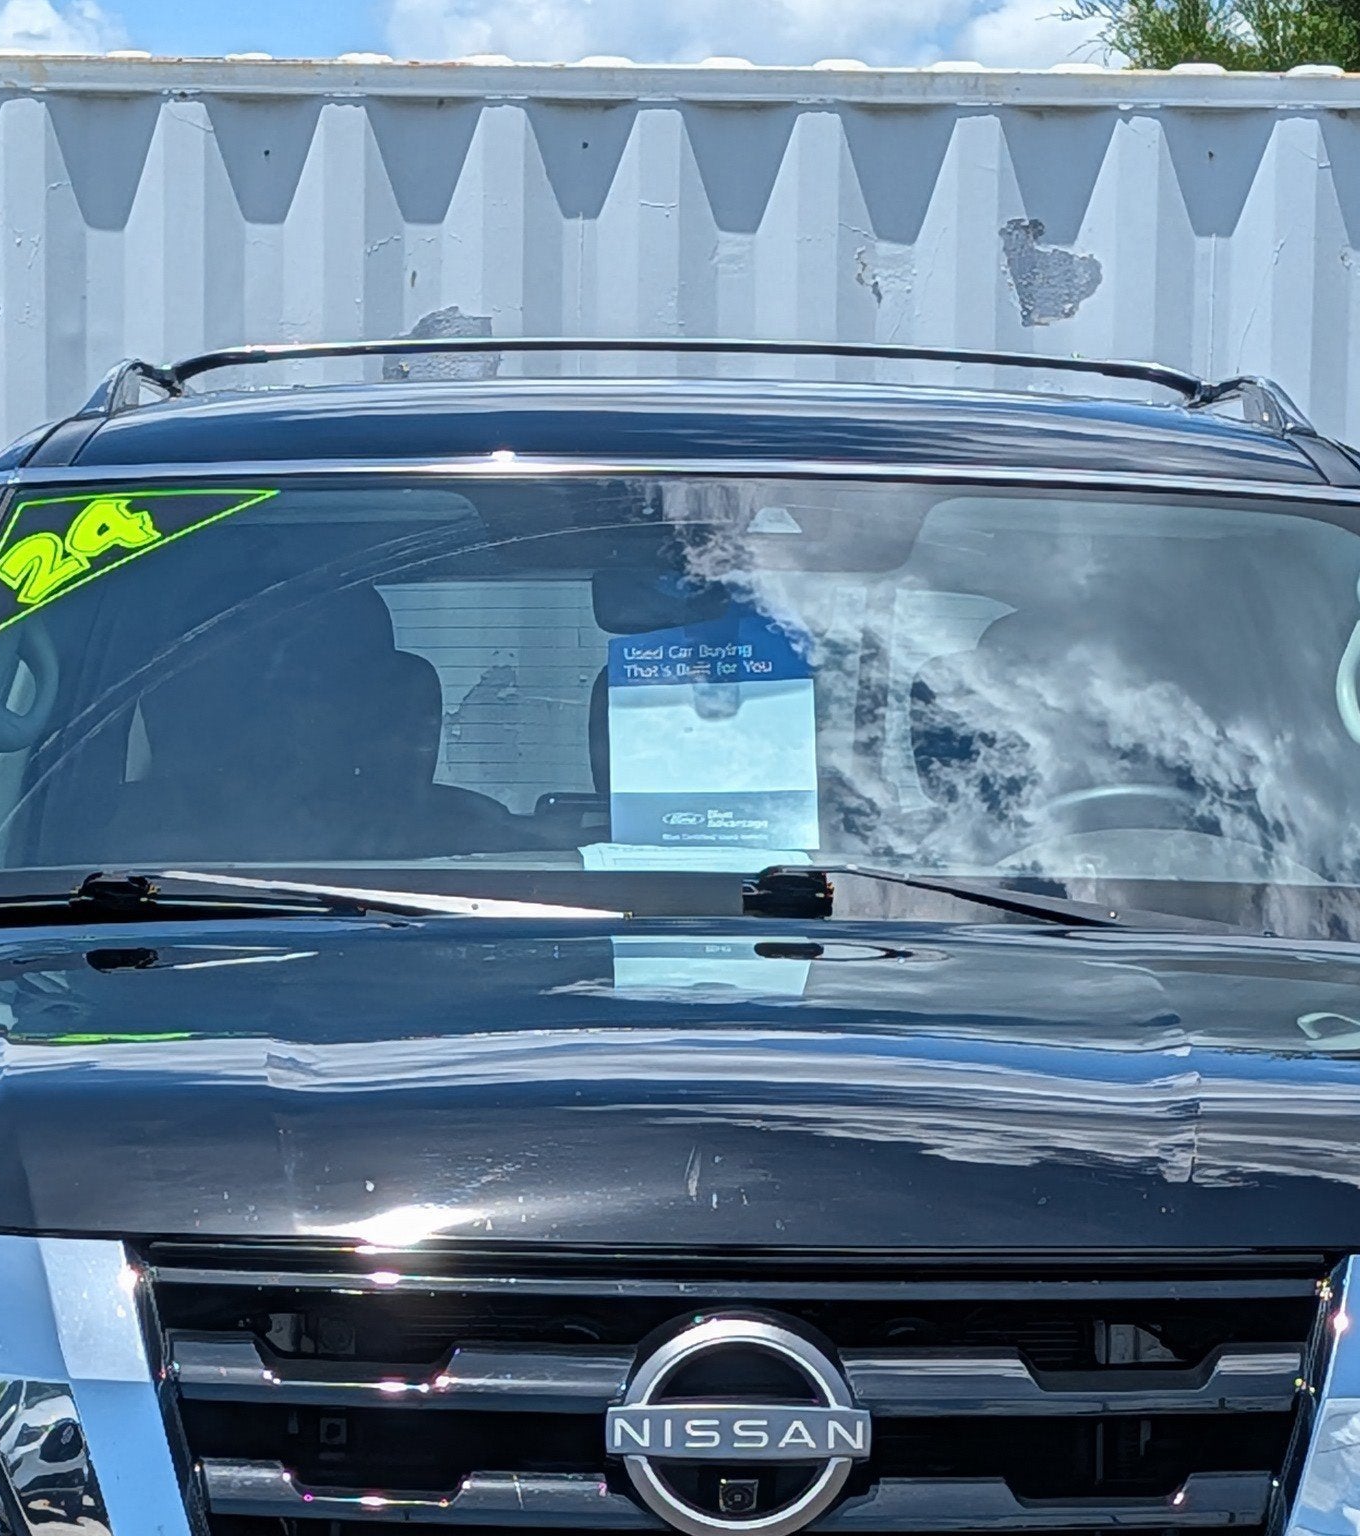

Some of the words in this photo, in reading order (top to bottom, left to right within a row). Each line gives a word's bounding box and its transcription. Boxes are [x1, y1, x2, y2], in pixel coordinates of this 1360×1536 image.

[623, 645, 663, 660] Used
[668, 645, 693, 660] Car
[699, 643, 753, 659] Buying
[623, 664, 672, 679] That's
[717, 660, 738, 675] for
[743, 660, 773, 674] You
[614, 1418, 864, 1450] NISSAN
